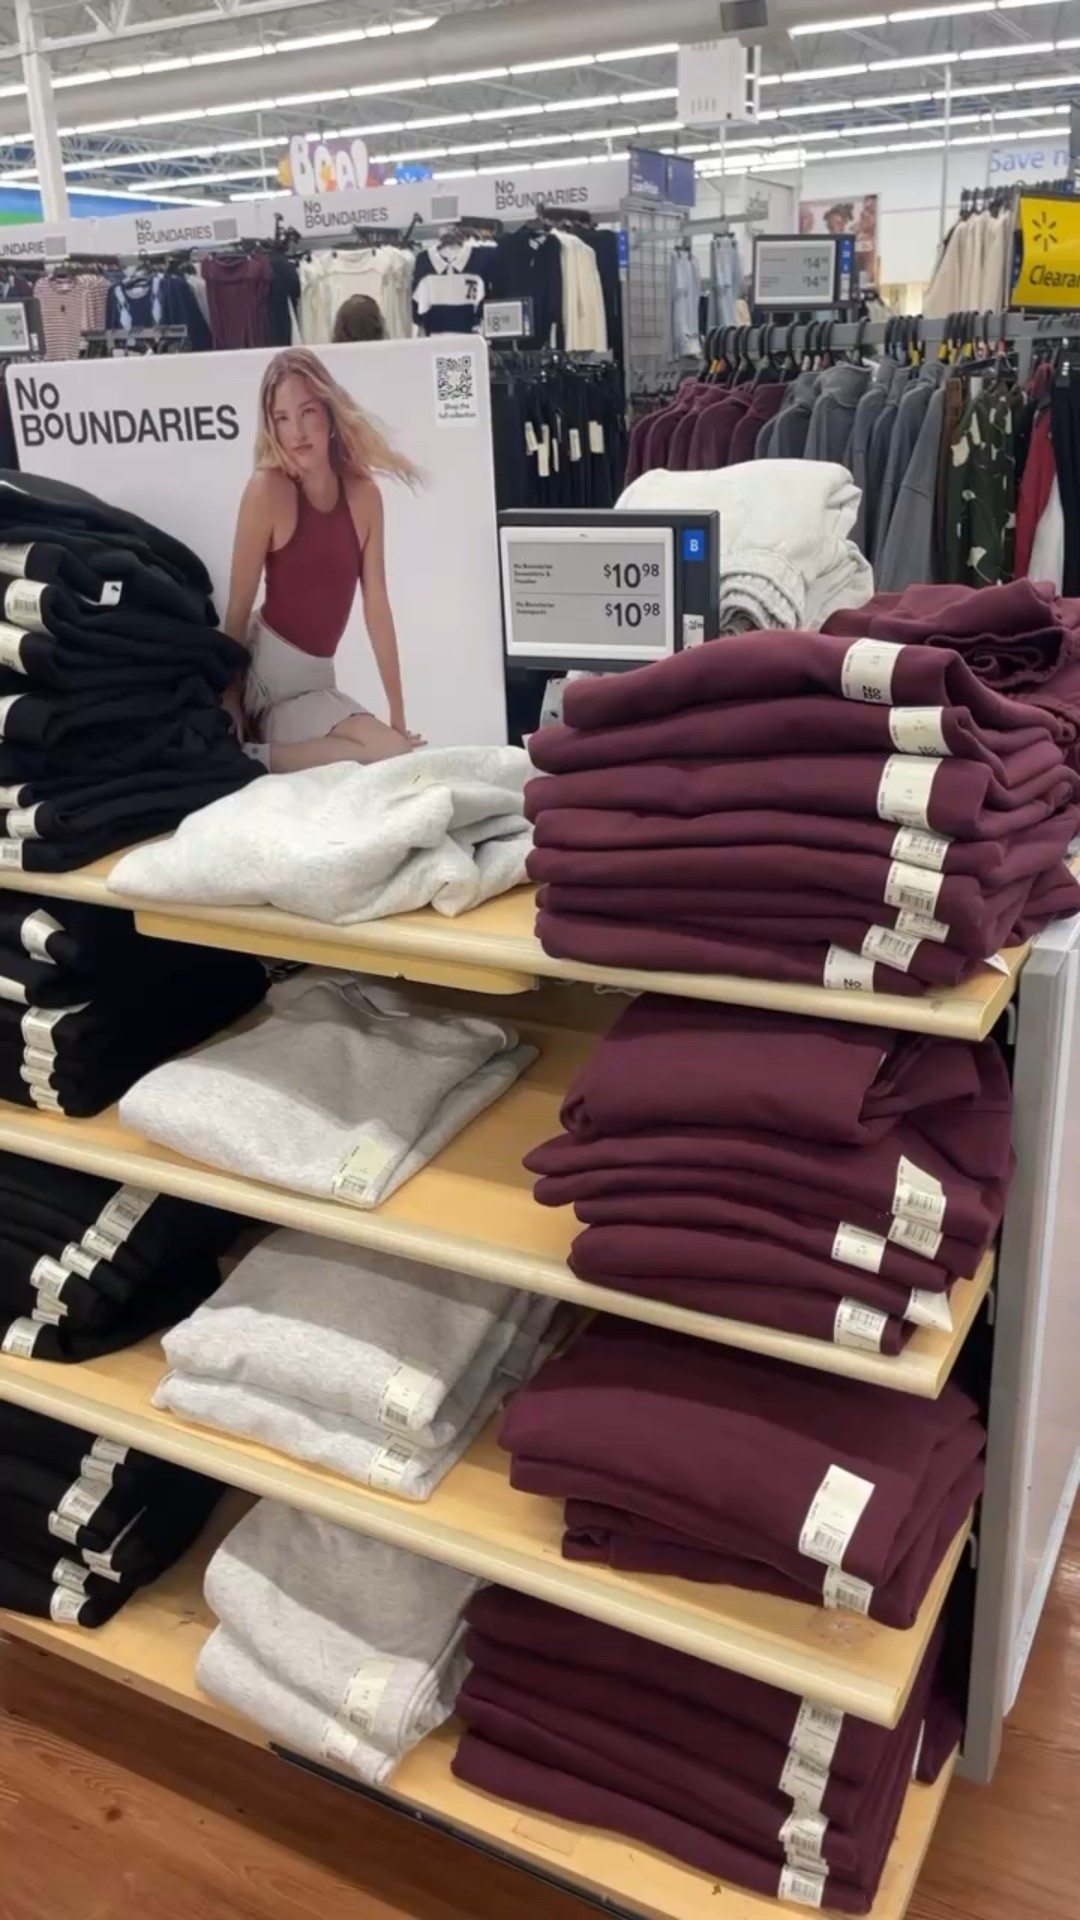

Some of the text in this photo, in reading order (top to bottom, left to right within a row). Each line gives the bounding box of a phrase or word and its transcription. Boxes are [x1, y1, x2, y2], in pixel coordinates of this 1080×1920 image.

[495, 180, 515, 195] No
[304, 200, 321, 214] No
[135, 219, 152, 231] No
[14, 377, 60, 410] No
[690, 539, 699, 552] B
